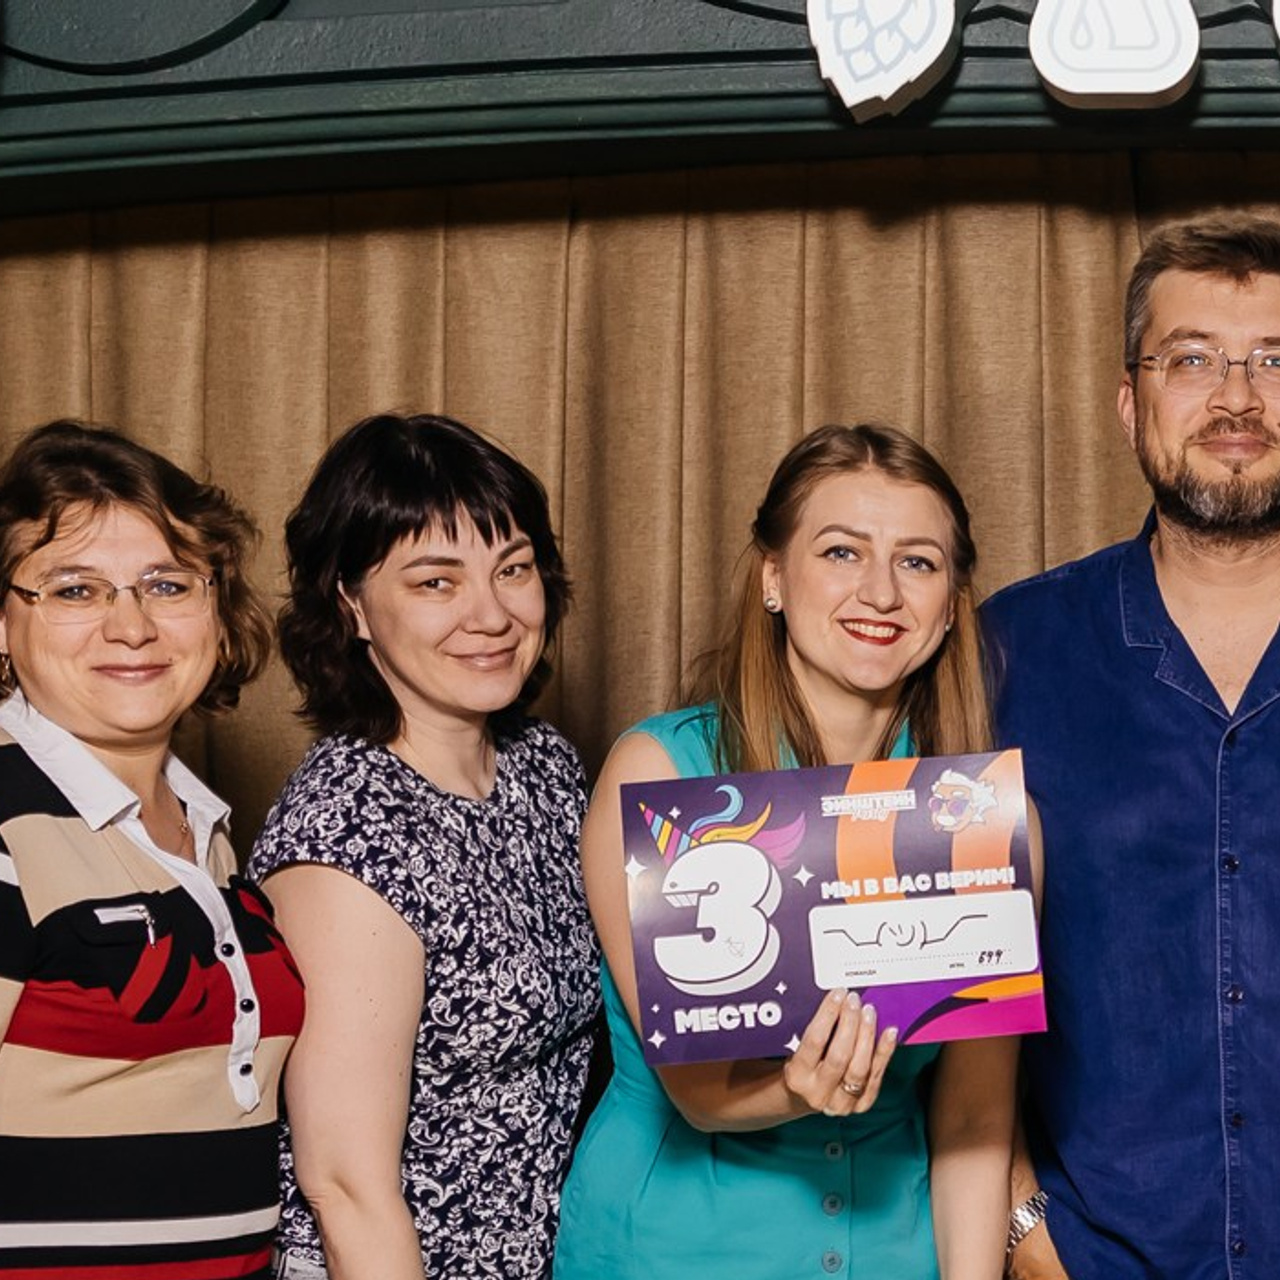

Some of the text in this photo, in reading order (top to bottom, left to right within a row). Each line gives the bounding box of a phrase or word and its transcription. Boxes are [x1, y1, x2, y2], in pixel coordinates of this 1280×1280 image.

[821, 866, 1016, 899] МЫ В ВАС ВЕРИМ!
[654, 841, 782, 996] 3
[674, 1001, 782, 1034] МЕСТО
